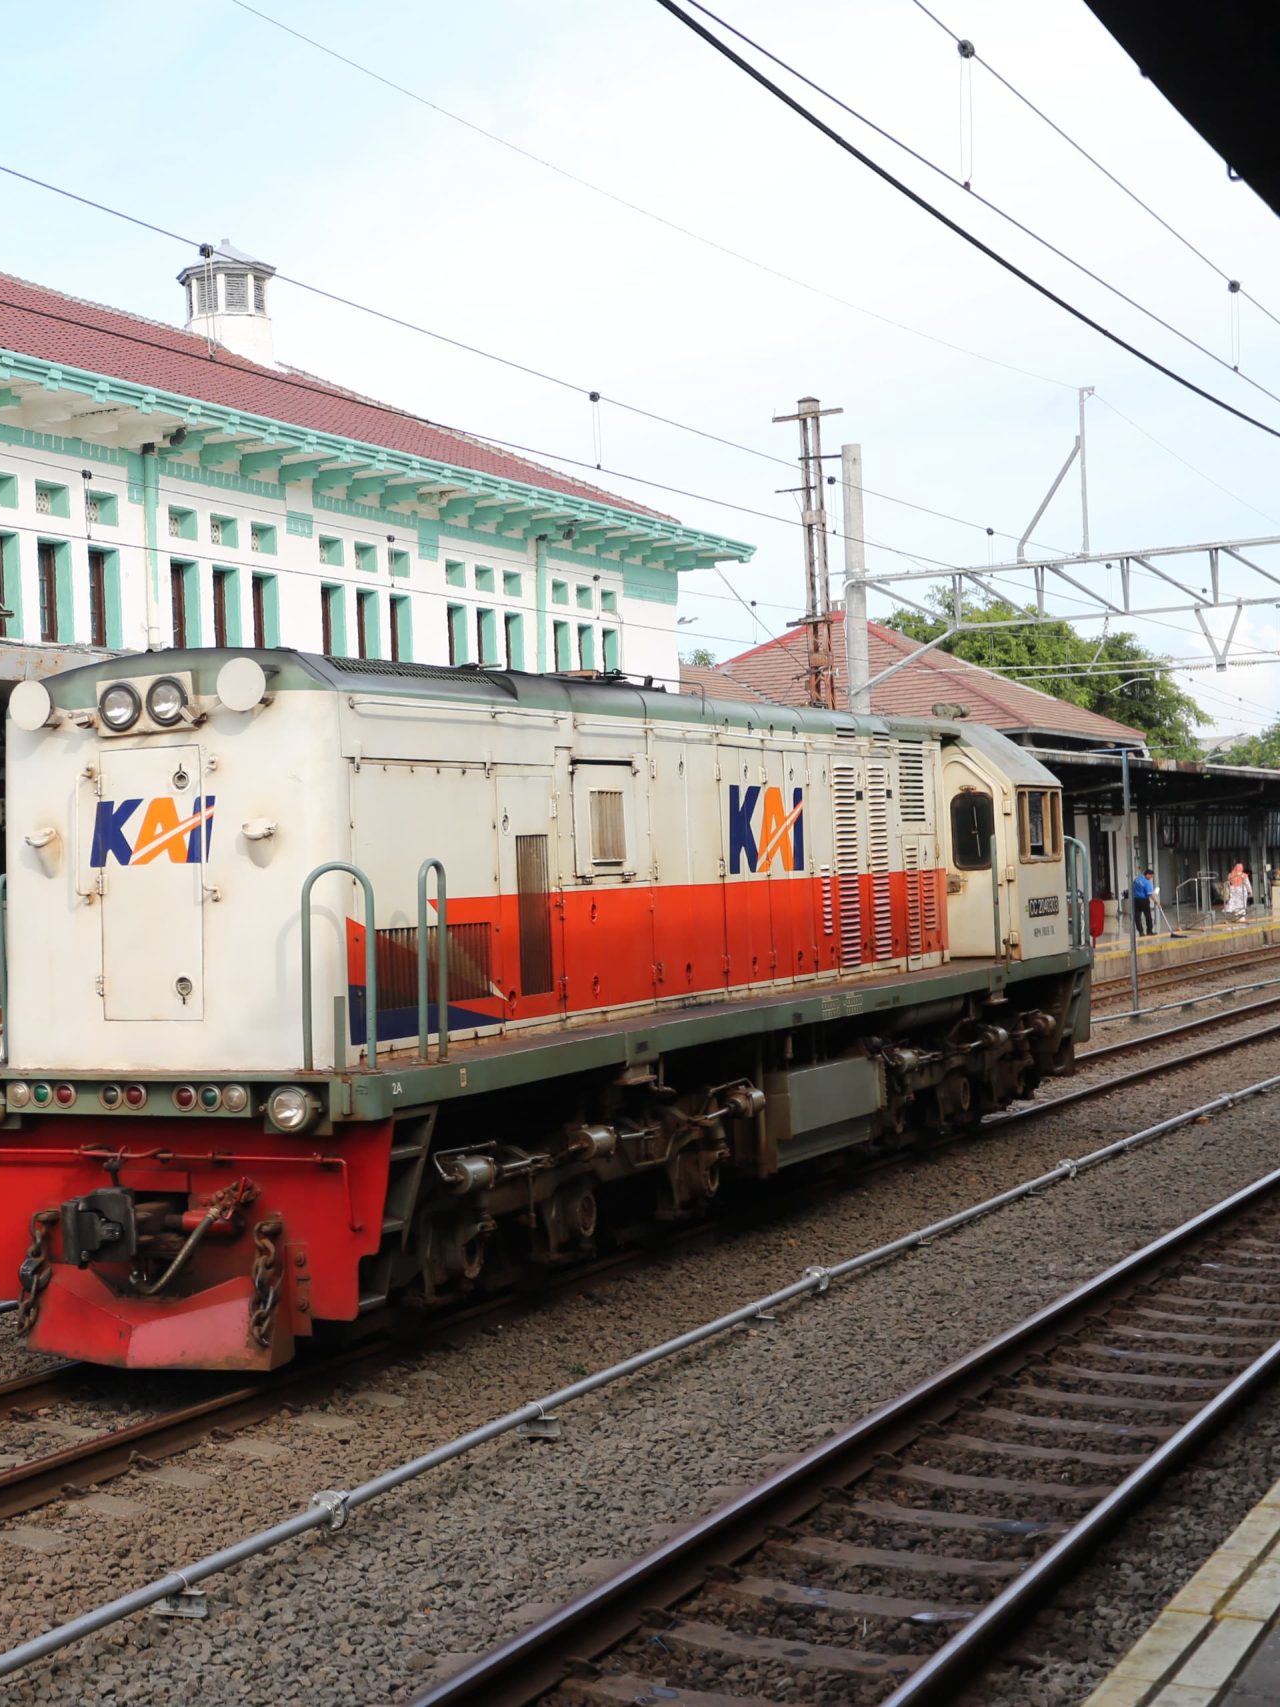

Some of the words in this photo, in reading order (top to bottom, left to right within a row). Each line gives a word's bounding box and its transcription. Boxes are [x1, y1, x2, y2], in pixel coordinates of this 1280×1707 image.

[90, 795, 216, 868] KAI
[729, 784, 804, 875] KAI
[392, 1082, 403, 1095] 2A
